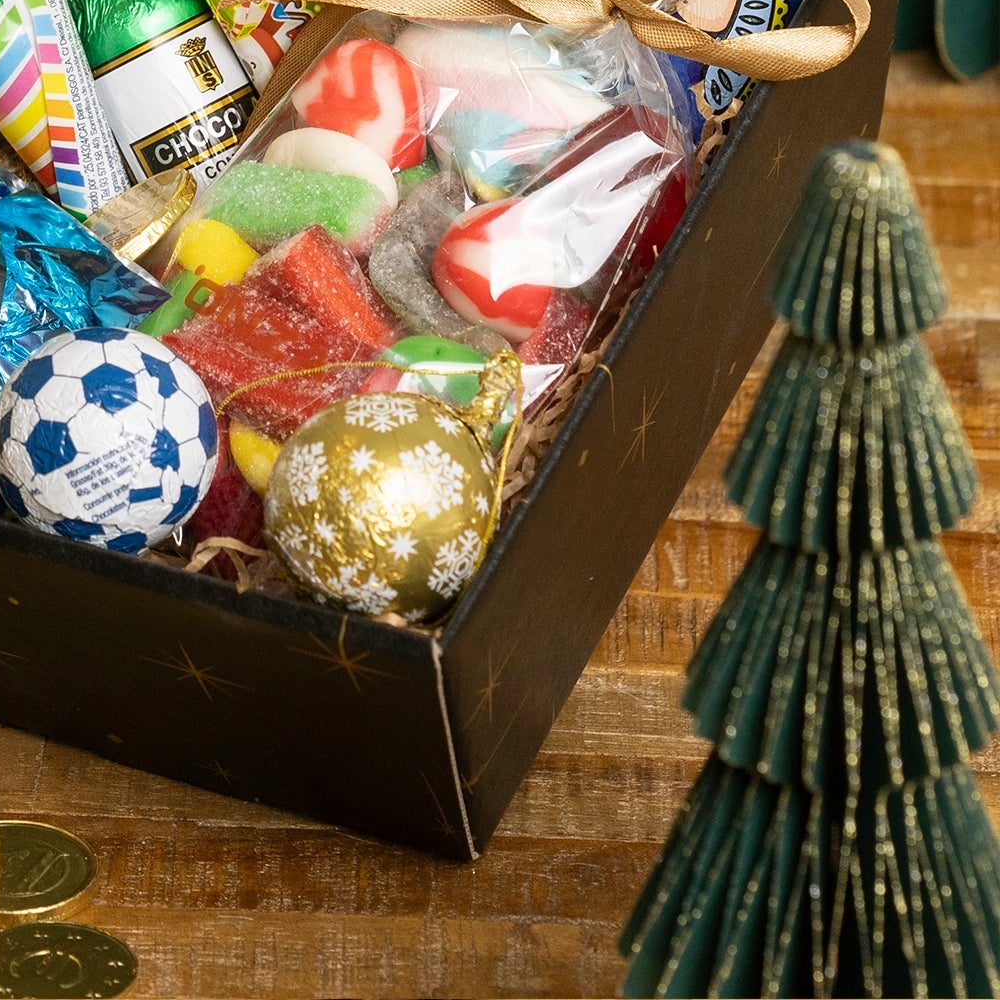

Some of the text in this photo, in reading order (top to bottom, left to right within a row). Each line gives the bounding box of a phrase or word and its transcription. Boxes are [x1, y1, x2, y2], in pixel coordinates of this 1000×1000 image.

[67, 73, 80, 102] DISGO
[74, 102, 85, 120] para
[91, 136, 101, 149] 40)
[152, 103, 248, 167] CHOCO
[94, 150, 103, 160] 58
[96, 161, 106, 176] 573
[87, 177, 98, 190] por
